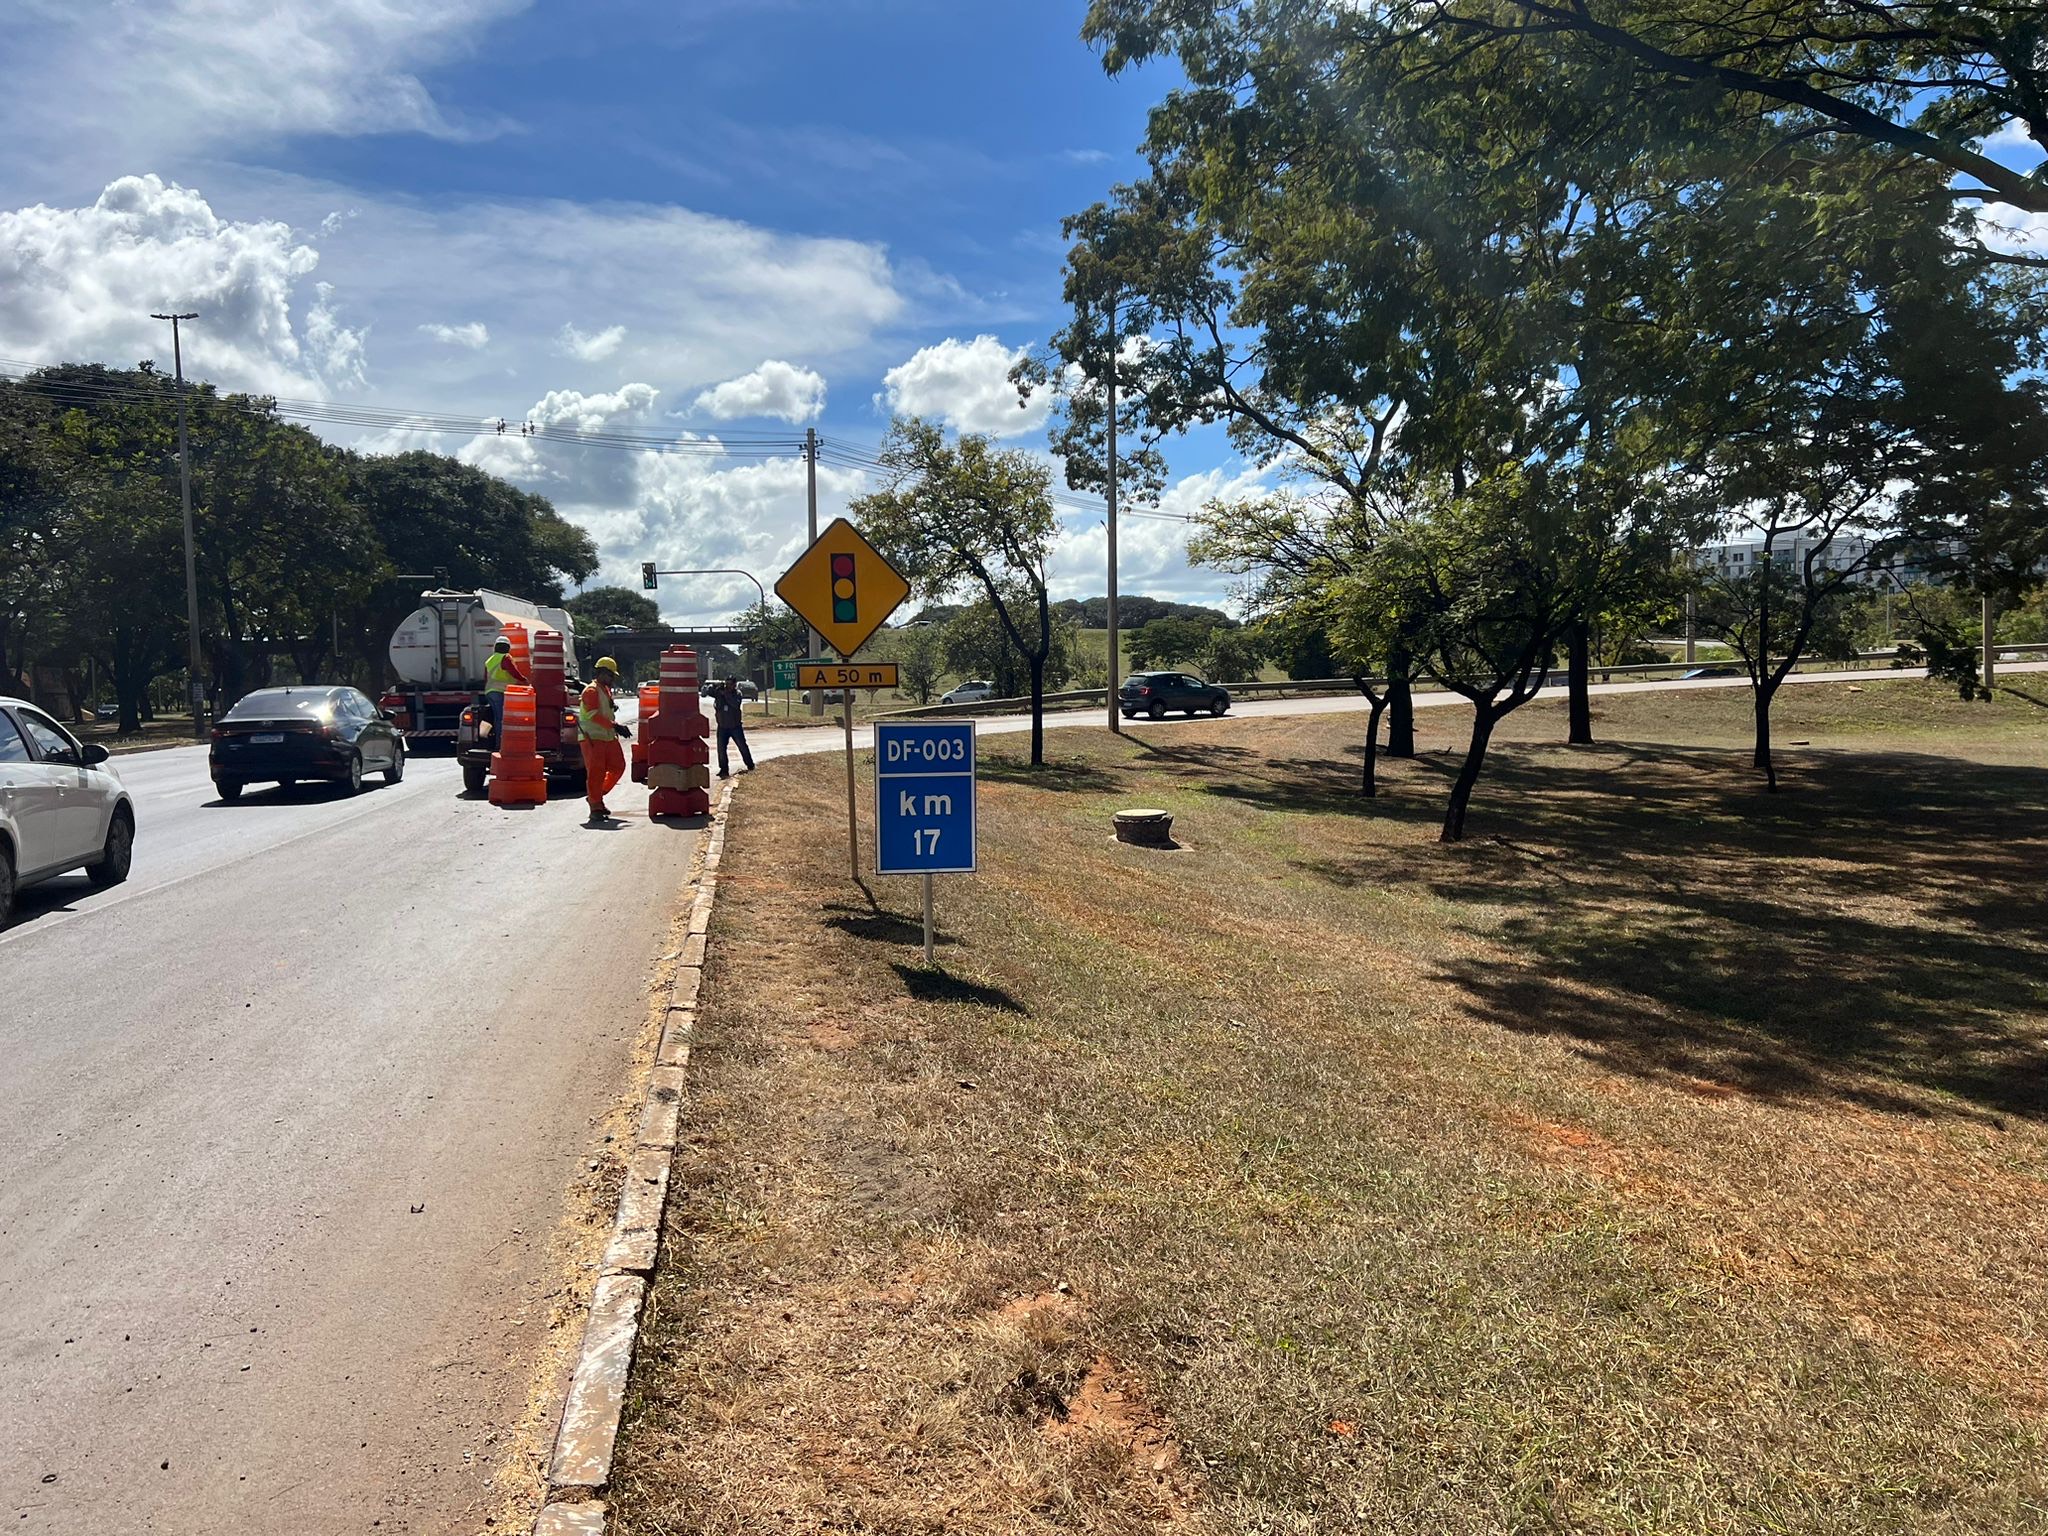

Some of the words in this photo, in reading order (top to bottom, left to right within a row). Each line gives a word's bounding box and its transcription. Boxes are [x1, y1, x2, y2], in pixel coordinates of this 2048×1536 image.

[814, 669, 828, 684] A
[837, 669, 860, 683] 50
[868, 672, 882, 683] m
[887, 738, 965, 762] DF-003
[900, 789, 952, 816] km
[913, 828, 941, 855] 17
